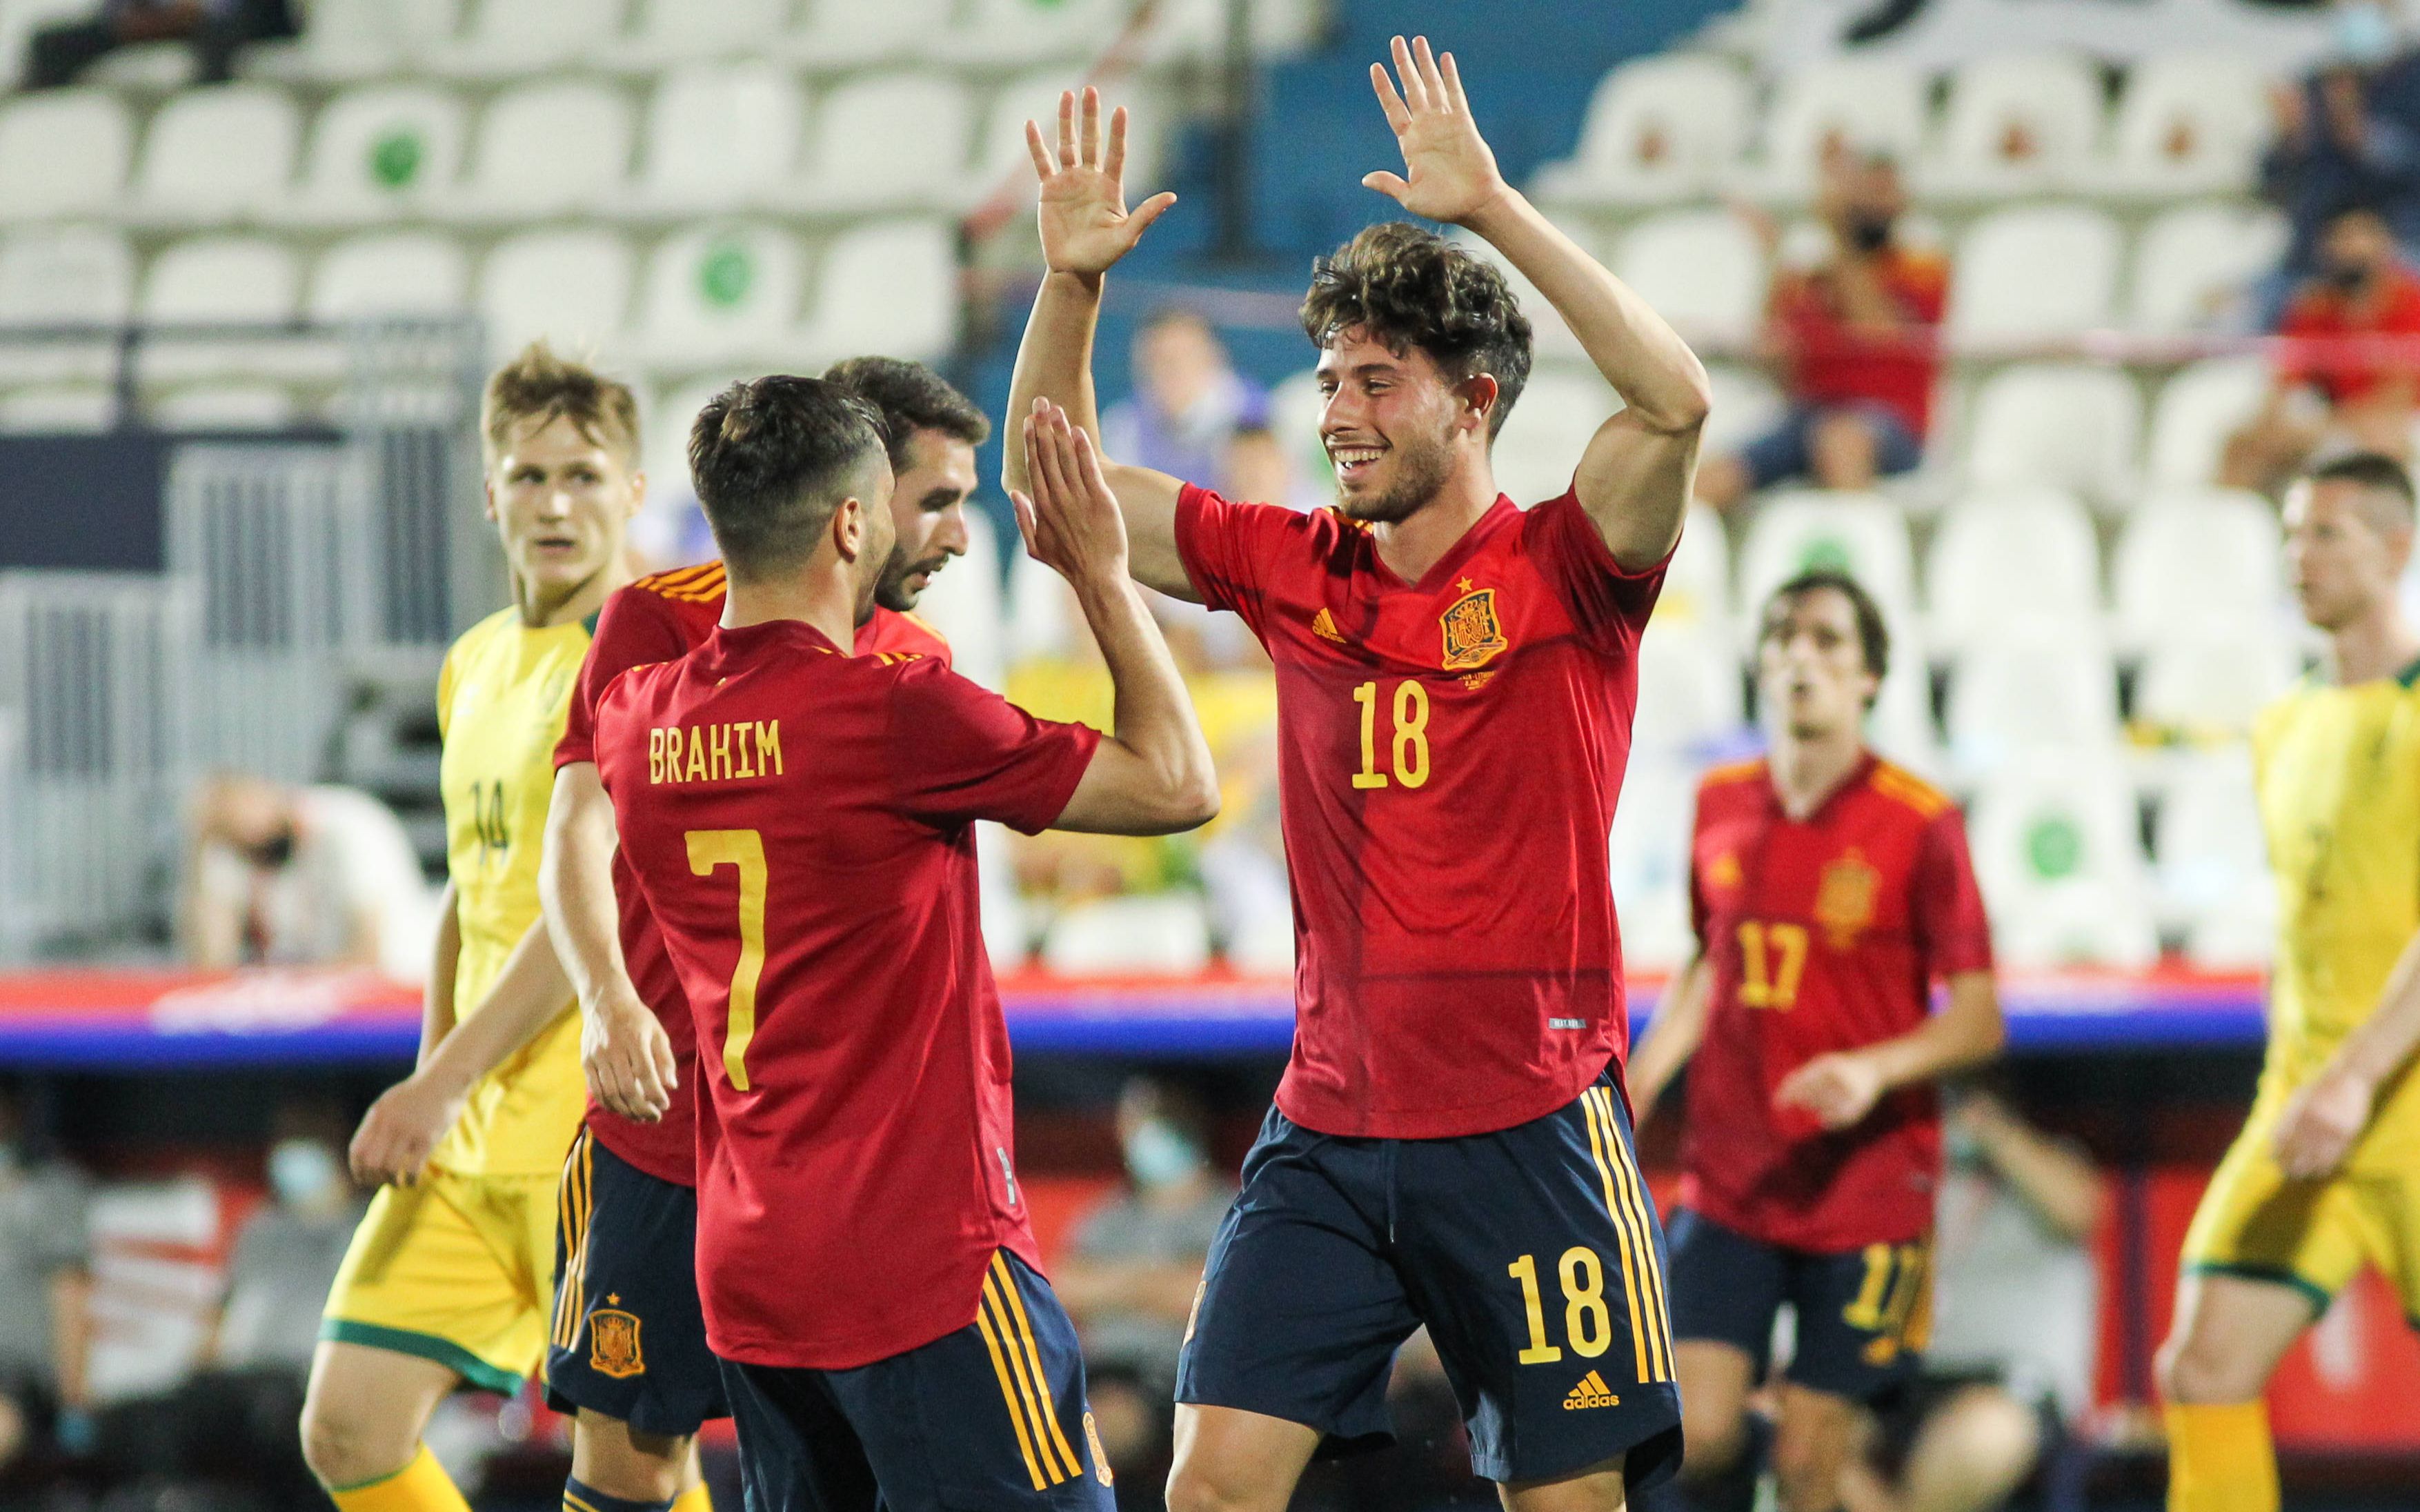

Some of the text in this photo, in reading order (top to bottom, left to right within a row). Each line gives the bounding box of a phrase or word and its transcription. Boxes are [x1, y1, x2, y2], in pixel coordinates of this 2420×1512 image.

[648, 719, 784, 785] BRAHIM
[1351, 679, 1430, 789] 18
[468, 780, 508, 864] 14
[684, 829, 768, 1092] 7
[1737, 919, 1809, 1013] 17
[1508, 1246, 1612, 1365] 18
[1563, 1393, 1620, 1411] adidas
